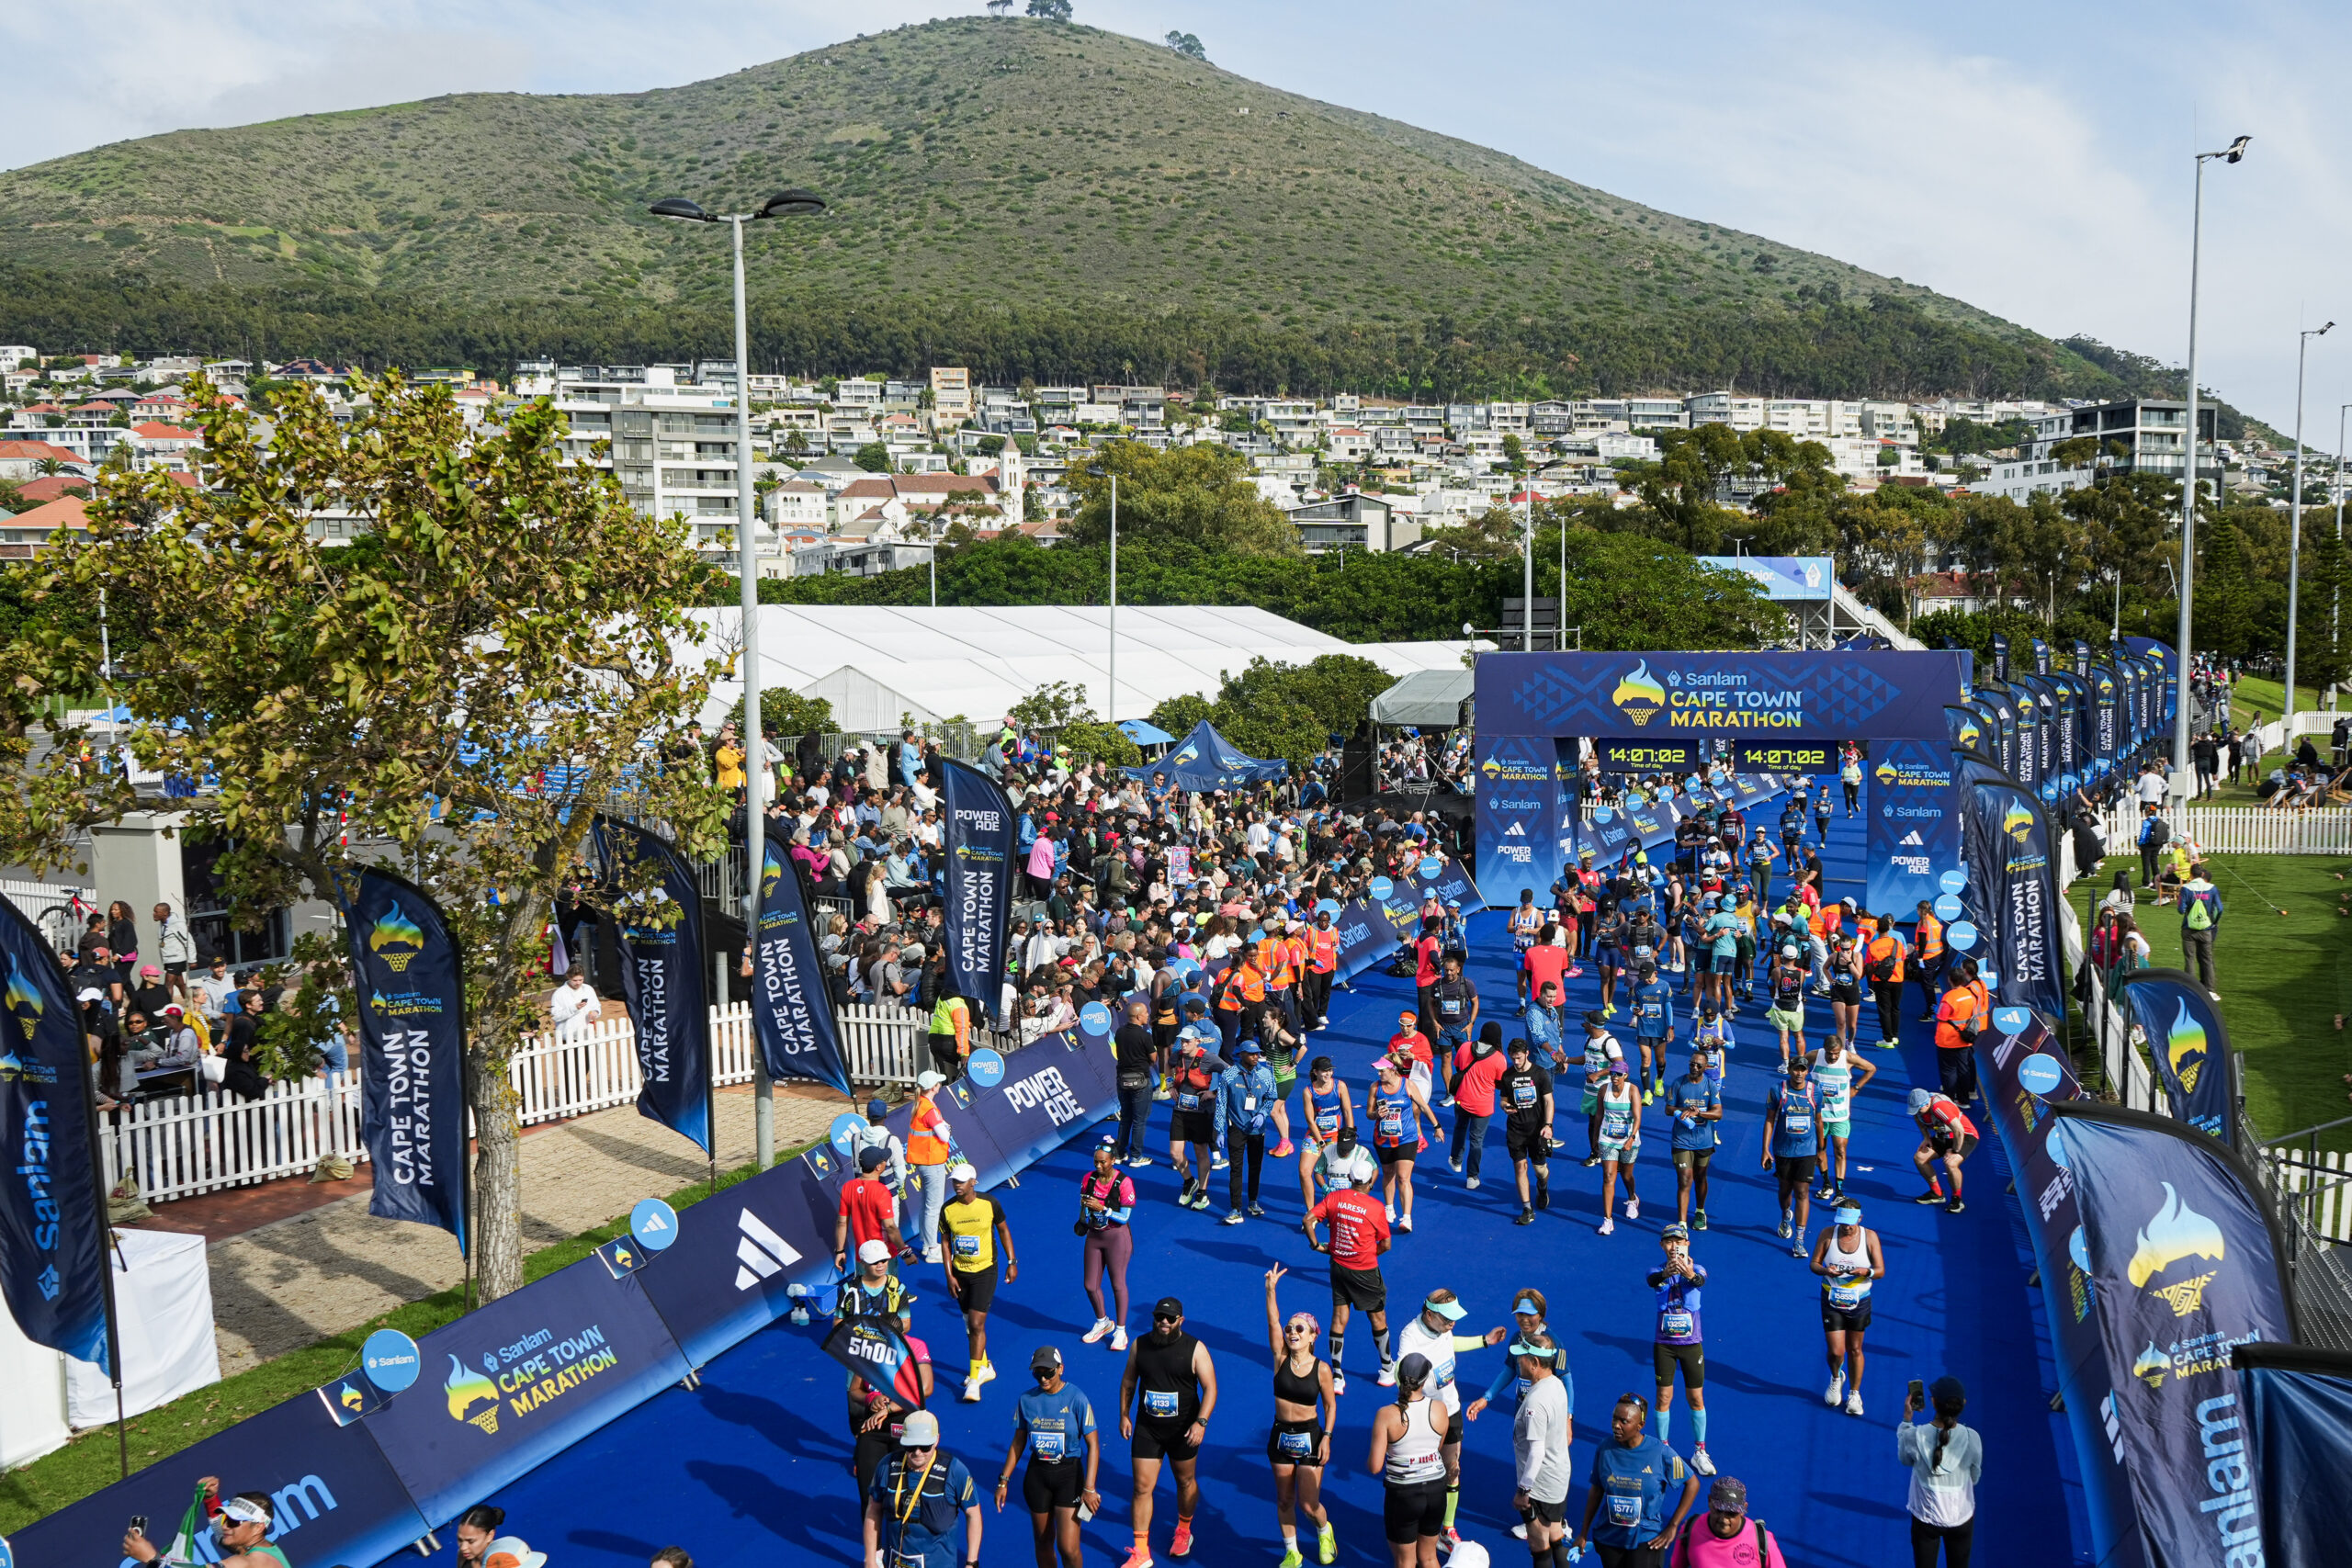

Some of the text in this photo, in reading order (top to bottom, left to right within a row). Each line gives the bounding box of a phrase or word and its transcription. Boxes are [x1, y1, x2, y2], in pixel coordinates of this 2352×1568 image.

[1686, 671, 1747, 687] Sanlam
[1670, 691, 1802, 708] CAPE TOWN
[1670, 710, 1802, 728] MARATHON
[1608, 748, 1685, 763] 14:07:02
[1744, 750, 1825, 764] 14:07:02
[1501, 799, 1541, 809] Sanlam
[955, 809, 1000, 820] POWER
[1896, 807, 1941, 818] Sanlam
[975, 820, 1000, 831] ADE
[1498, 845, 1532, 854] POWER
[1512, 854, 1532, 863] ADE
[1891, 856, 1929, 865] POWER
[1908, 865, 1929, 874] ADE
[1438, 878, 1468, 901] Sanlam
[763, 910, 798, 923] CAPE TOWN
[962, 870, 978, 973] CAPE TOWN
[976, 870, 993, 973] MARATHON
[764, 918, 798, 931] MARATHON
[2025, 879, 2045, 981] MARATHON
[1339, 921, 1372, 948] Sanlam
[2012, 883, 2029, 983] CAPE TOWN
[1781, 976, 1792, 992] 9
[392, 991, 421, 999] Sanlam
[760, 942, 800, 1055] CAPE TOWN
[774, 938, 818, 1052] MARATHON
[388, 998, 442, 1009] CAPE TOWN
[388, 1006, 443, 1016] MARATHON
[638, 957, 653, 1081] CAPE TOWN
[650, 959, 670, 1082] MARATHON
[1082, 1012, 1106, 1021] POWER
[23, 1065, 39, 1073] CAPE
[971, 1061, 999, 1069] POWER
[984, 1066, 999, 1075] ADE
[23, 1074, 58, 1083] MARATHON
[2030, 1069, 2057, 1079] Sanlam
[1003, 1066, 1069, 1113] POWER
[382, 1032, 415, 1185] CAPE TOWN
[408, 1030, 434, 1186] MARATHON
[1044, 1089, 1084, 1126] ADE
[17, 1100, 61, 1251] Sanlam
[1337, 1201, 1367, 1215] NARESH
[1337, 1213, 1363, 1224] FINISHER
[499, 1328, 553, 1363] Sanlam
[2181, 1330, 2225, 1348] Sanlam
[379, 1354, 415, 1366] Sanlam
[499, 1325, 605, 1393] CAPE TOWN
[2173, 1346, 2213, 1366] CAPE
[2175, 1355, 2233, 1380] MARAT
[509, 1346, 618, 1417] MARATHON
[1035, 1440, 1058, 1449] 22477
[2196, 1393, 2266, 1568] anlam
[1613, 1504, 1634, 1514] 15777
